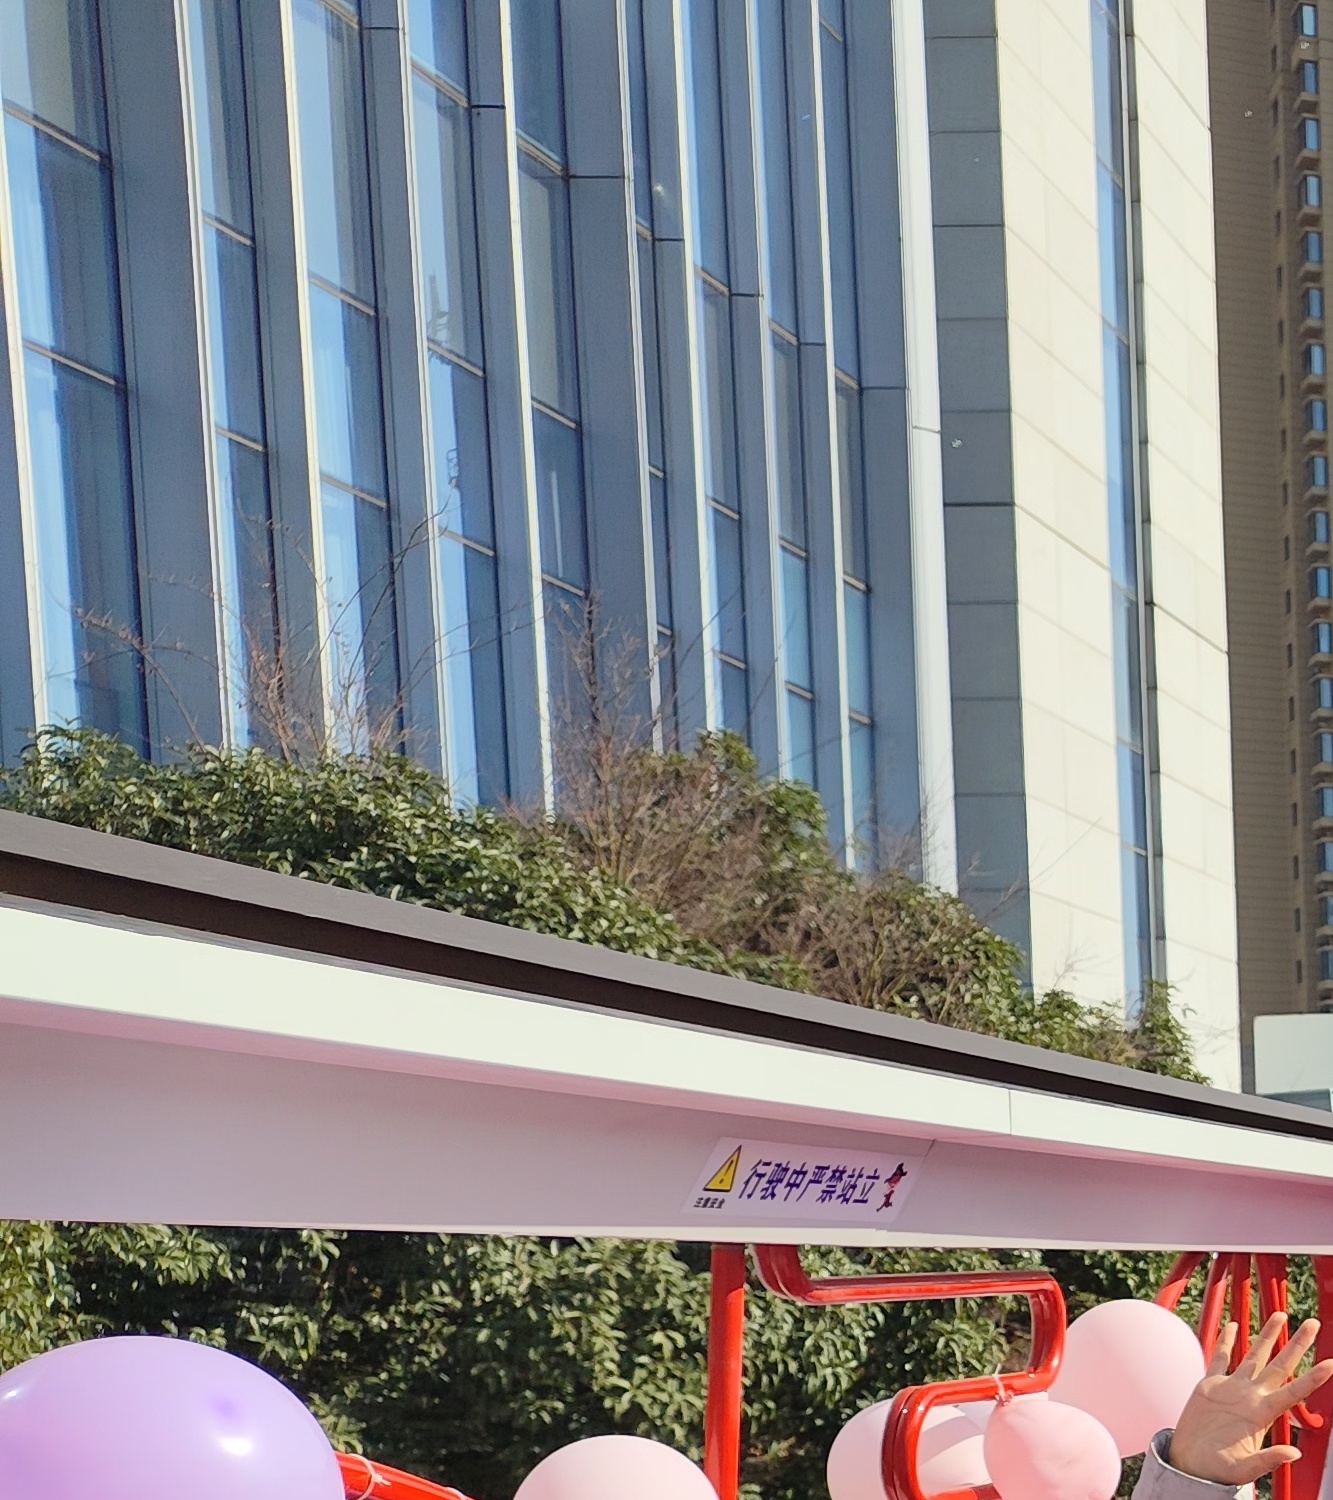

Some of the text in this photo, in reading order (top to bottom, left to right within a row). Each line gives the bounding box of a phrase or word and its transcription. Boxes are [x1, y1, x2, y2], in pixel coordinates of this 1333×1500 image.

[738, 1158, 880, 1205] 行驶中严禁站立
